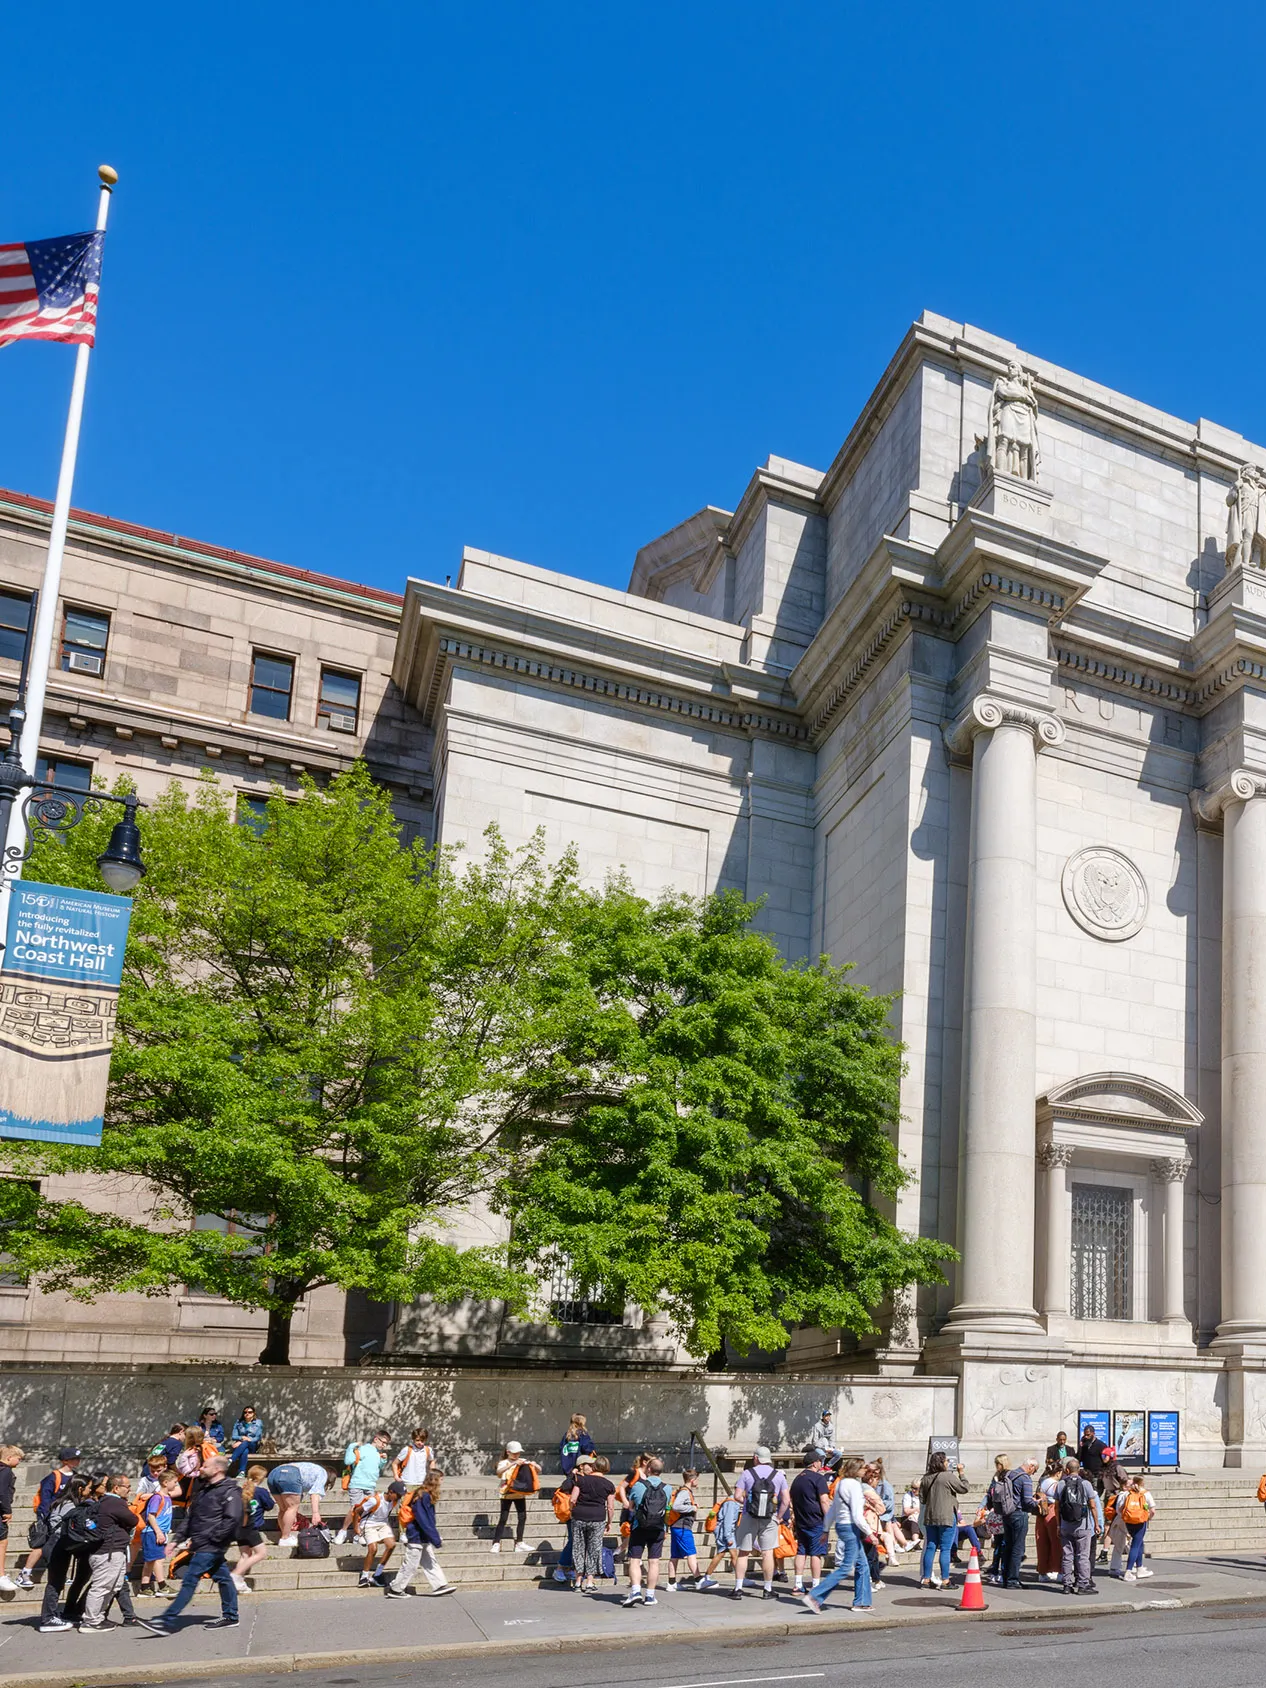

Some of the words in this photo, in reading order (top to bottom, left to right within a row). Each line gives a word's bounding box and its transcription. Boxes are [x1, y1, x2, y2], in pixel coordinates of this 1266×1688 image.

[1002, 493, 1043, 517] BOONE
[1063, 685, 1185, 745] RUTH
[60, 899, 92, 909] AMERICAN
[93, 904, 121, 913] MUSEUM
[66, 905, 93, 914] NATURAL
[94, 909, 120, 918] HISTORY
[17, 920, 33, 928] the
[34, 921, 54, 933] fully
[55, 926, 100, 938] revitalized
[18, 911, 70, 926] Introducing
[15, 930, 115, 957] Northwest
[13, 945, 65, 965] Coast
[69, 953, 106, 971] Hall
